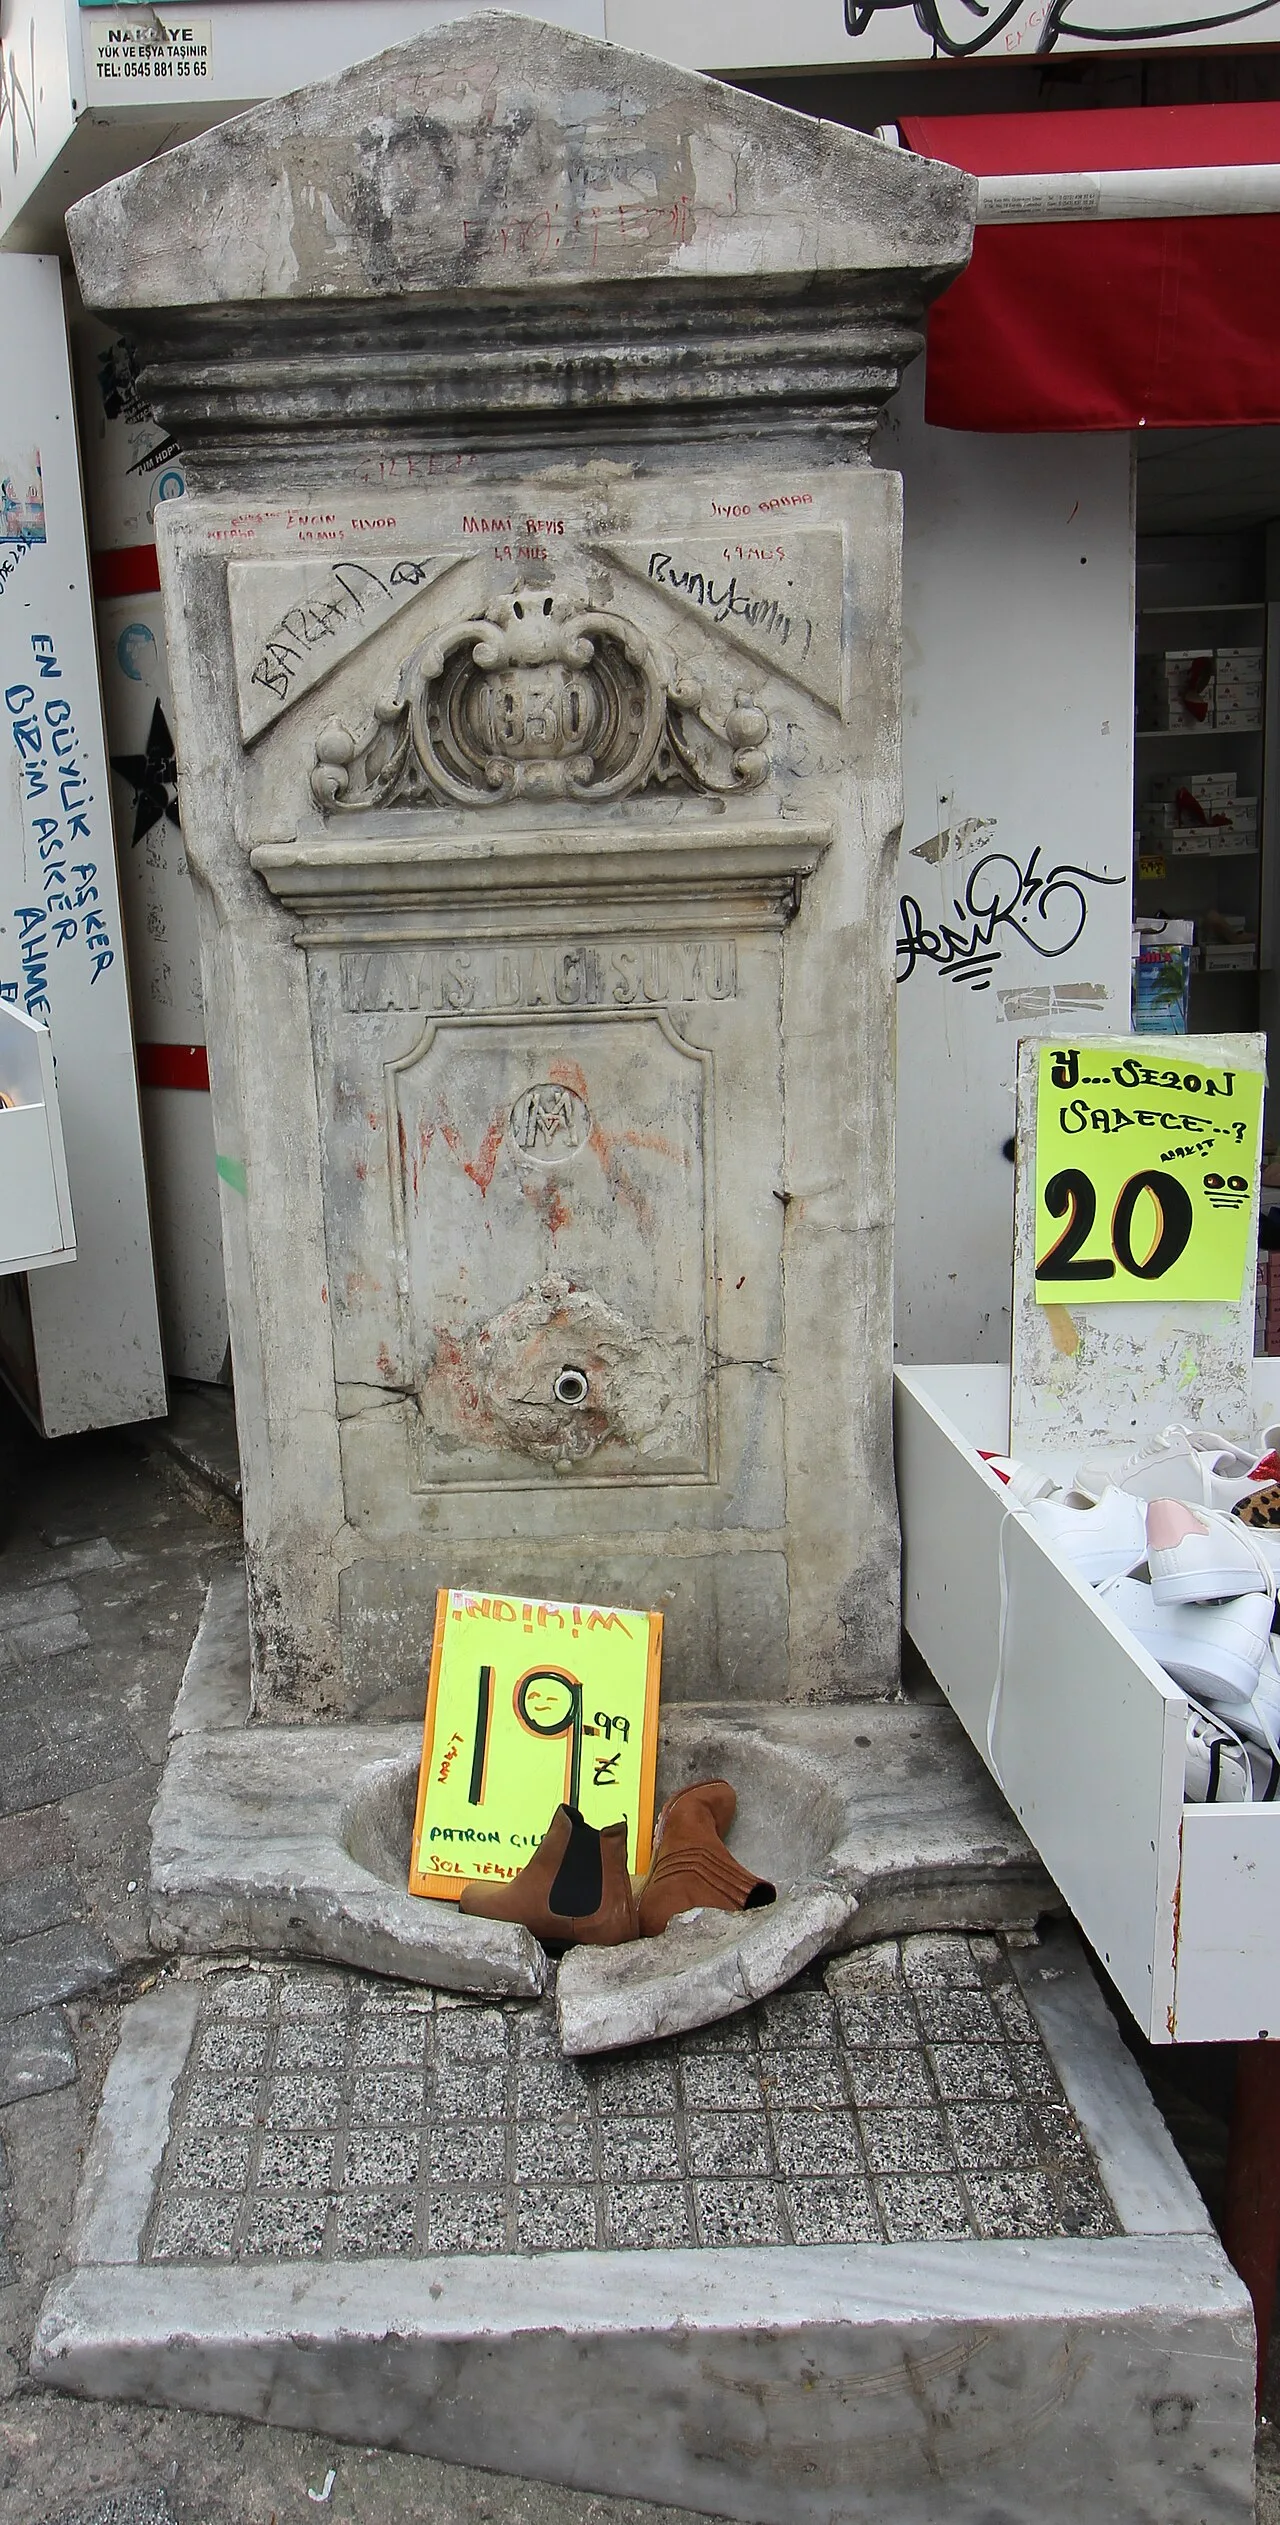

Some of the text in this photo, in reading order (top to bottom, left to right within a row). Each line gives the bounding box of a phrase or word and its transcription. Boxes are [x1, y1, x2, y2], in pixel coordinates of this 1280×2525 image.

[98, 45, 207, 60] YÜK VE EŞYA TAŞINIR
[97, 61, 207, 77] TEL: 0545 881 55 65
[30, 633, 63, 679] EN
[13, 907, 53, 1019] AHME
[1035, 1168, 1193, 1281] 20
[430, 1826, 501, 1844] PATRON
[426, 1855, 465, 1875] SOL
